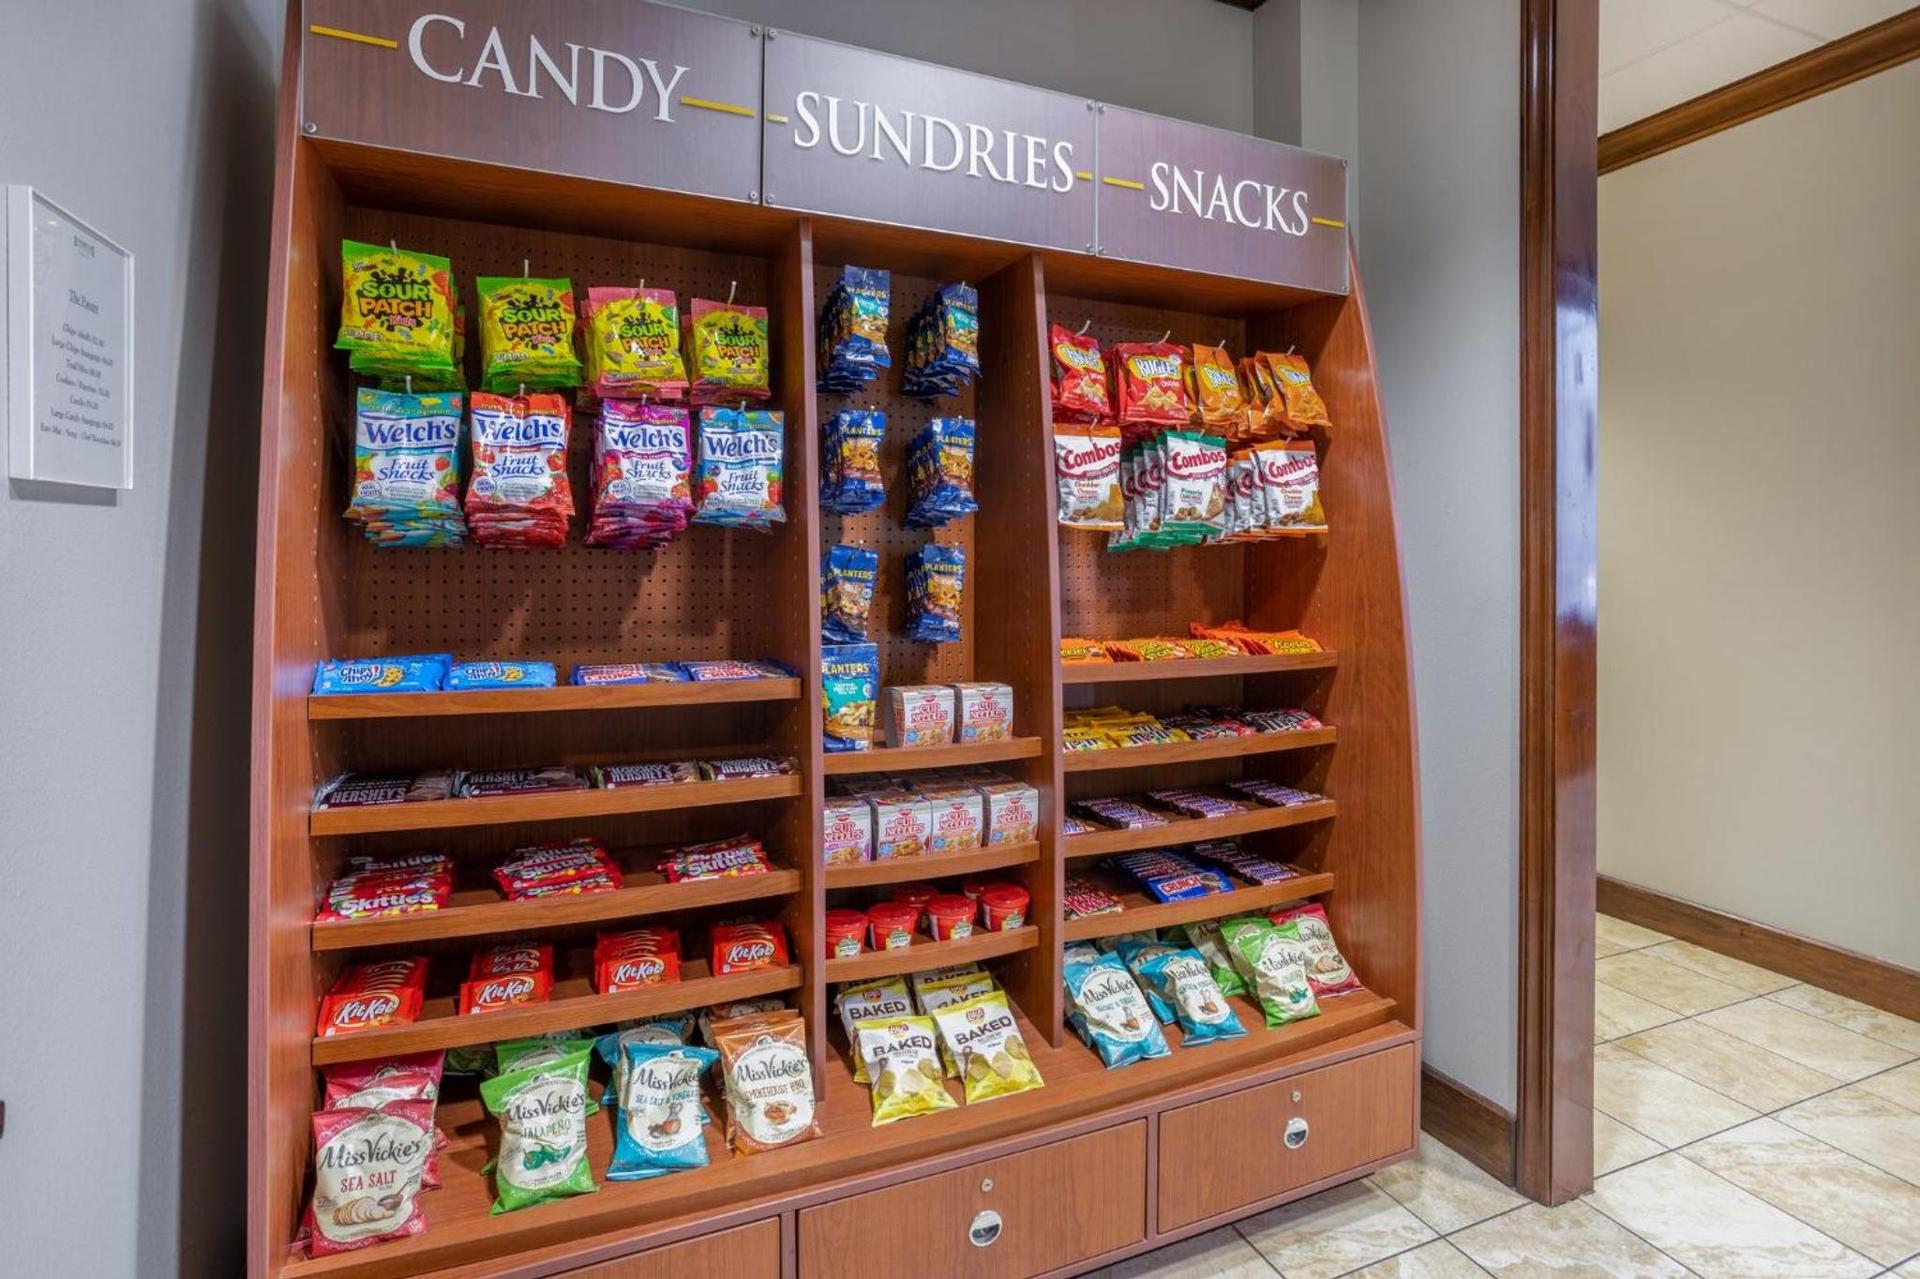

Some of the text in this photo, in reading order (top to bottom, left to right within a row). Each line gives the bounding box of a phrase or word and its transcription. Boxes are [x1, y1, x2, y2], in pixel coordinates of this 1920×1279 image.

[407, 13, 689, 123] CANDY
[793, 91, 1074, 194] SUNDRIES
[1149, 161, 1309, 237] SNACKS
[362, 280, 429, 300] SOUR
[360, 297, 432, 318] PATCH
[502, 308, 561, 322] SOUR
[502, 322, 567, 339] PATCH
[620, 324, 664, 338] SOUR
[717, 332, 756, 346] SOUR
[718, 345, 760, 358] PATCH
[363, 420, 456, 444] Welch's
[476, 419, 563, 440] Welch's
[612, 427, 684, 449] Welch's
[706, 435, 778, 456] Welch's
[503, 455, 537, 466] Fruit
[1064, 442, 1120, 469] Combos
[1173, 449, 1225, 470] Combos
[391, 459, 429, 470] Fruit
[492, 464, 545, 477] Snacks
[633, 460, 665, 471] Fruit
[1269, 455, 1317, 478] Combos
[377, 467, 435, 481] Snacks
[626, 468, 671, 480] Snacks
[728, 470, 758, 482] Fruit
[720, 480, 765, 492] Snacks
[834, 568, 874, 580] PLANTERS
[924, 563, 963, 573] PLANTERS
[918, 703, 941, 712] CUP
[977, 701, 1000, 711] CUP
[911, 711, 948, 723] NOODLES
[969, 708, 1007, 721] NOODLES
[470, 770, 535, 784] HERSHEY'S
[330, 787, 406, 804] HERSHEY'S
[948, 810, 969, 821] CUP
[1005, 803, 1025, 815] CUP
[895, 815, 917, 827] CUP
[939, 817, 976, 831] NOODLES
[997, 812, 1032, 826] NOODLES
[833, 821, 855, 832] CUP
[885, 824, 924, 837] NOODLES
[825, 829, 864, 843] NOODLES
[1161, 876, 1200, 893] CRUNCH
[341, 891, 433, 916] Skittles
[849, 1000, 906, 1020] BAKED
[954, 1016, 1012, 1045] BAKED
[873, 1035, 932, 1057] BAKED
[633, 1068, 668, 1090] Miss
[736, 1064, 767, 1086] Miss
[536, 1091, 585, 1117] Vickie's
[319, 1132, 421, 1170] Miss Vickie's
[340, 1170, 397, 1193] SEA SALT
